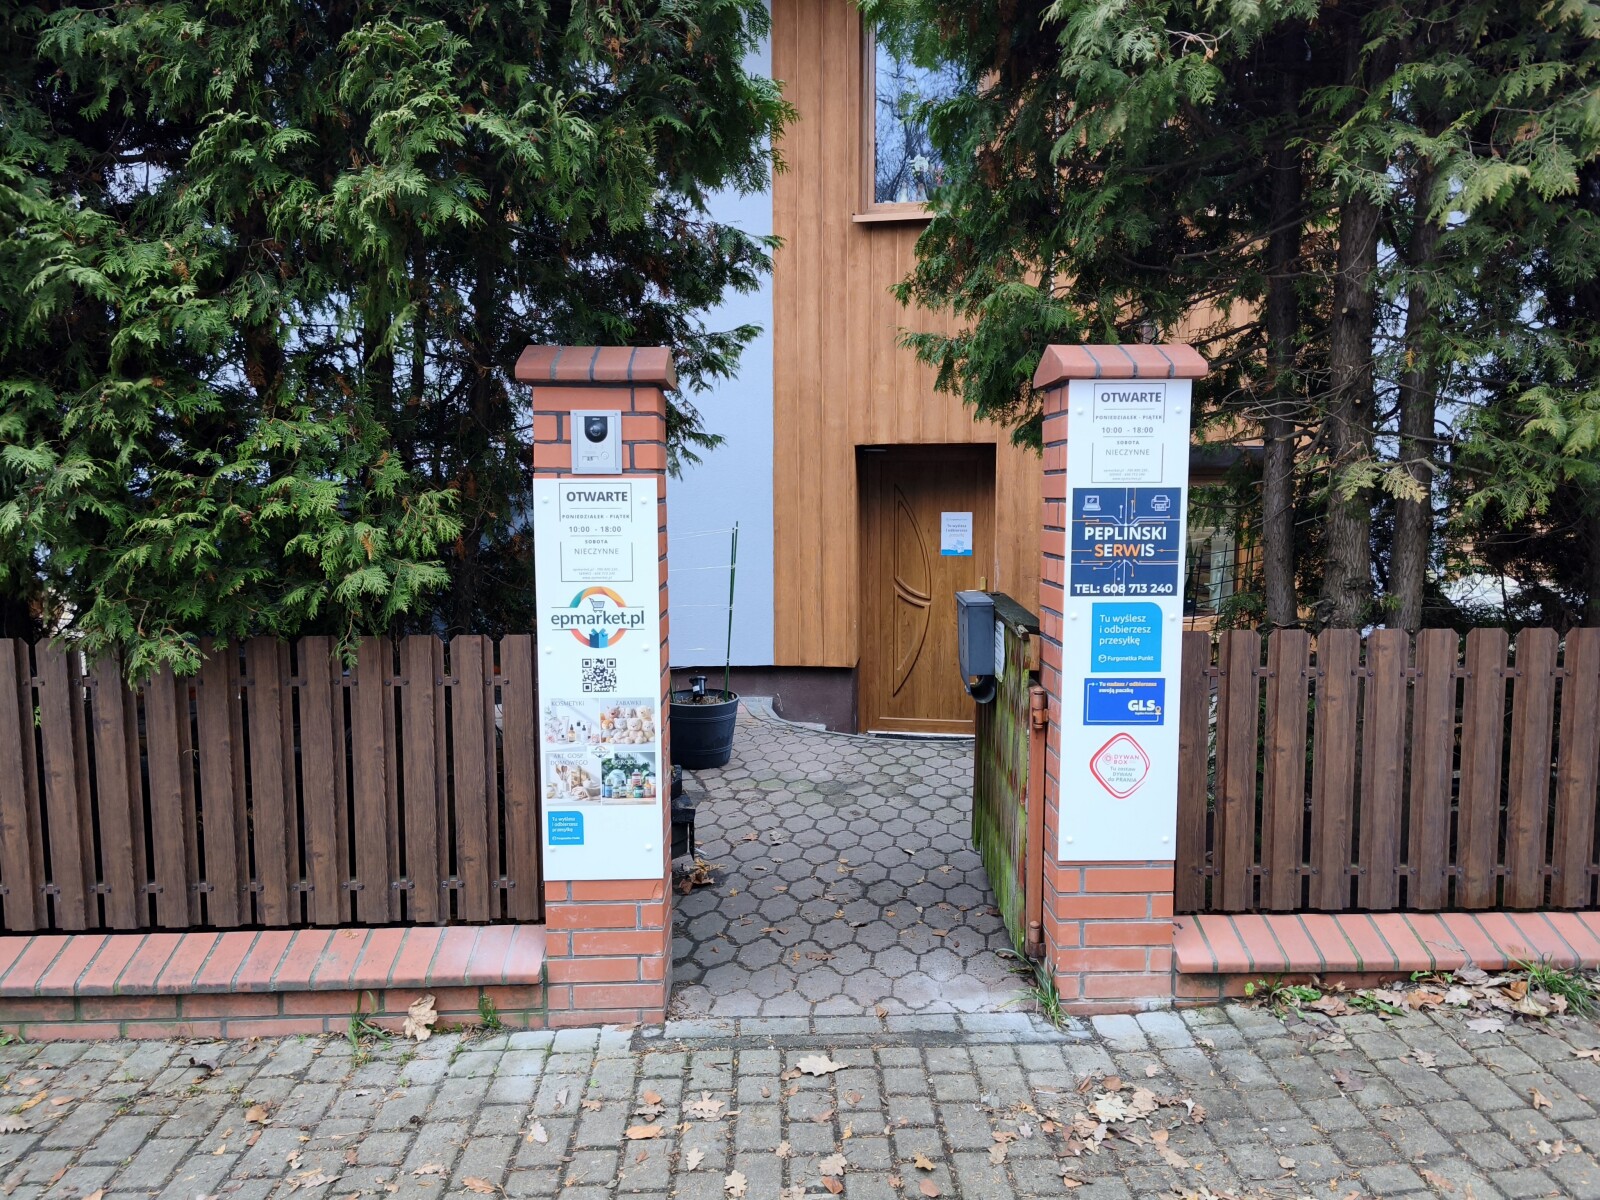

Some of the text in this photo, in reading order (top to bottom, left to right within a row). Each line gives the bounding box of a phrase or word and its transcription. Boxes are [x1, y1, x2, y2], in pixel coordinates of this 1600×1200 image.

[1101, 392, 1162, 403] OTWARTE
[566, 492, 628, 502] OTWARTE
[1094, 544, 1155, 556] SERWIS
[1074, 584, 1173, 593] TEL: 608 713 240
[551, 610, 644, 628] epmarket.pl
[1100, 614, 1146, 624] Tu wyślesz
[1104, 625, 1152, 634] odbierzesz
[1099, 636, 1140, 646] przesyłkę
[1128, 700, 1156, 711] GLS
